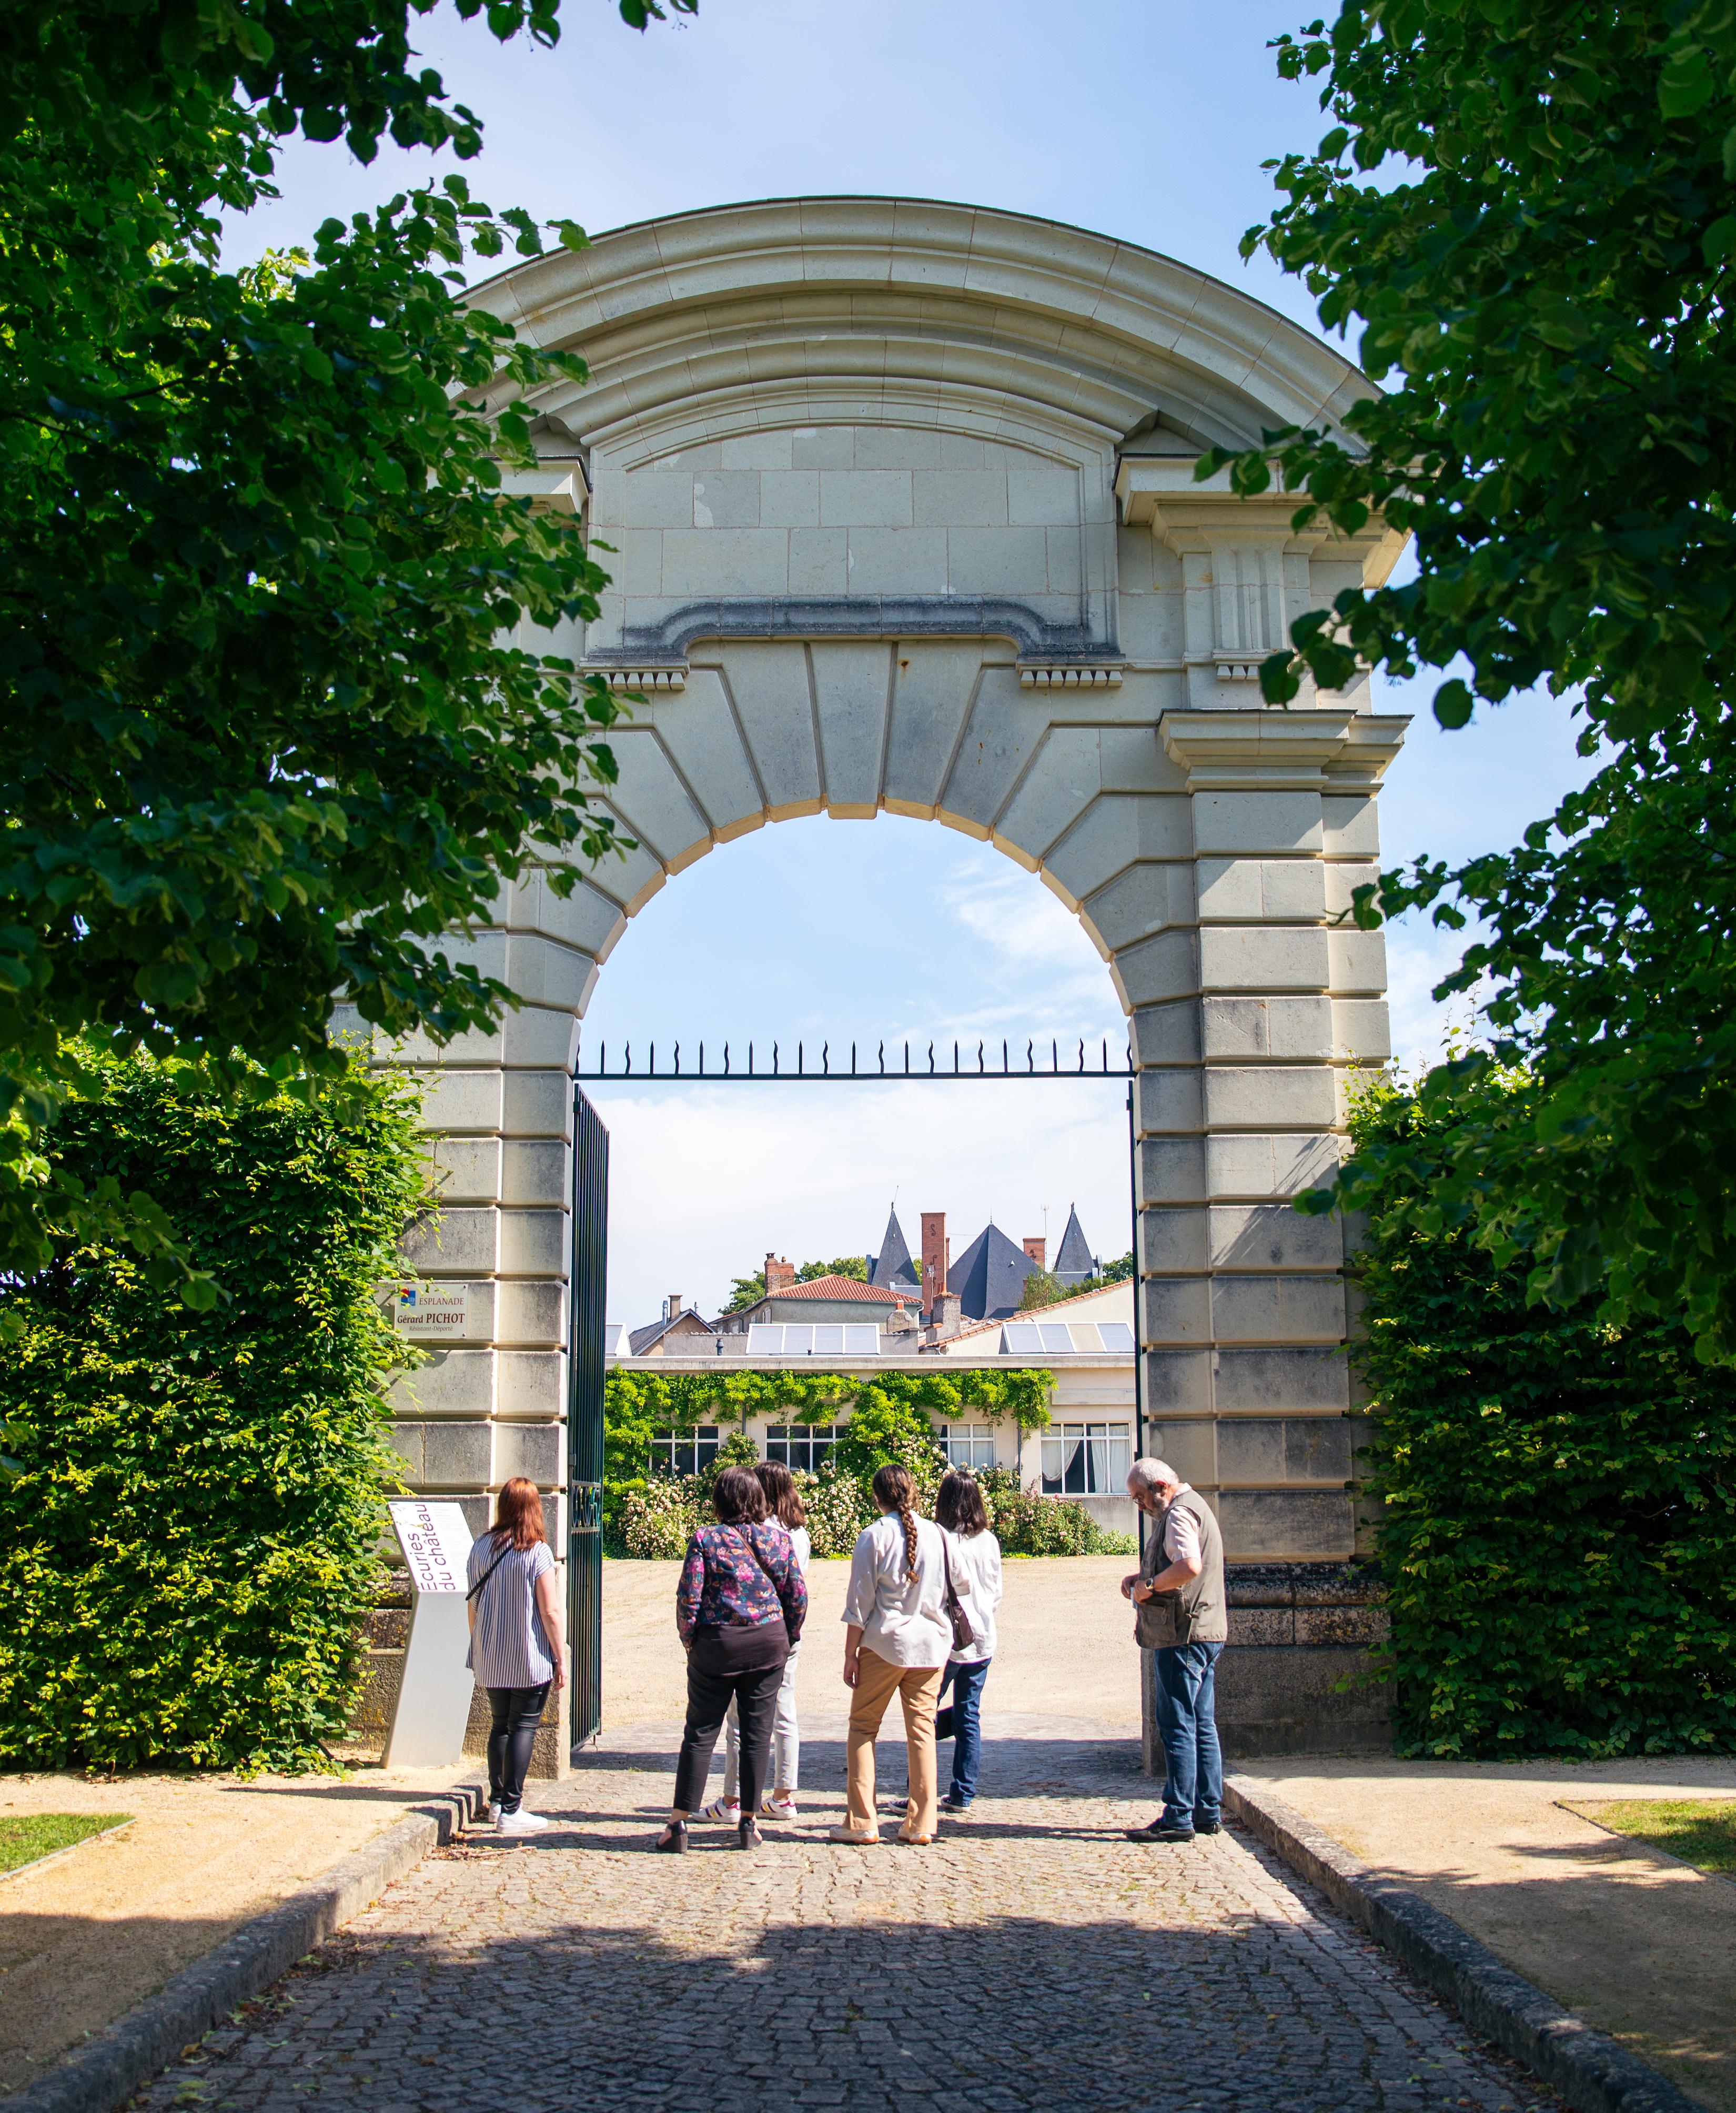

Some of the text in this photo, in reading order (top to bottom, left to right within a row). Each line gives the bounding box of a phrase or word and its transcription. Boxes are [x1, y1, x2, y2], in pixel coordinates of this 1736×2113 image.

[426, 1313, 465, 1323] PICHOT
[408, 1533, 438, 1590] Écuries
[415, 1504, 456, 1590] du château
